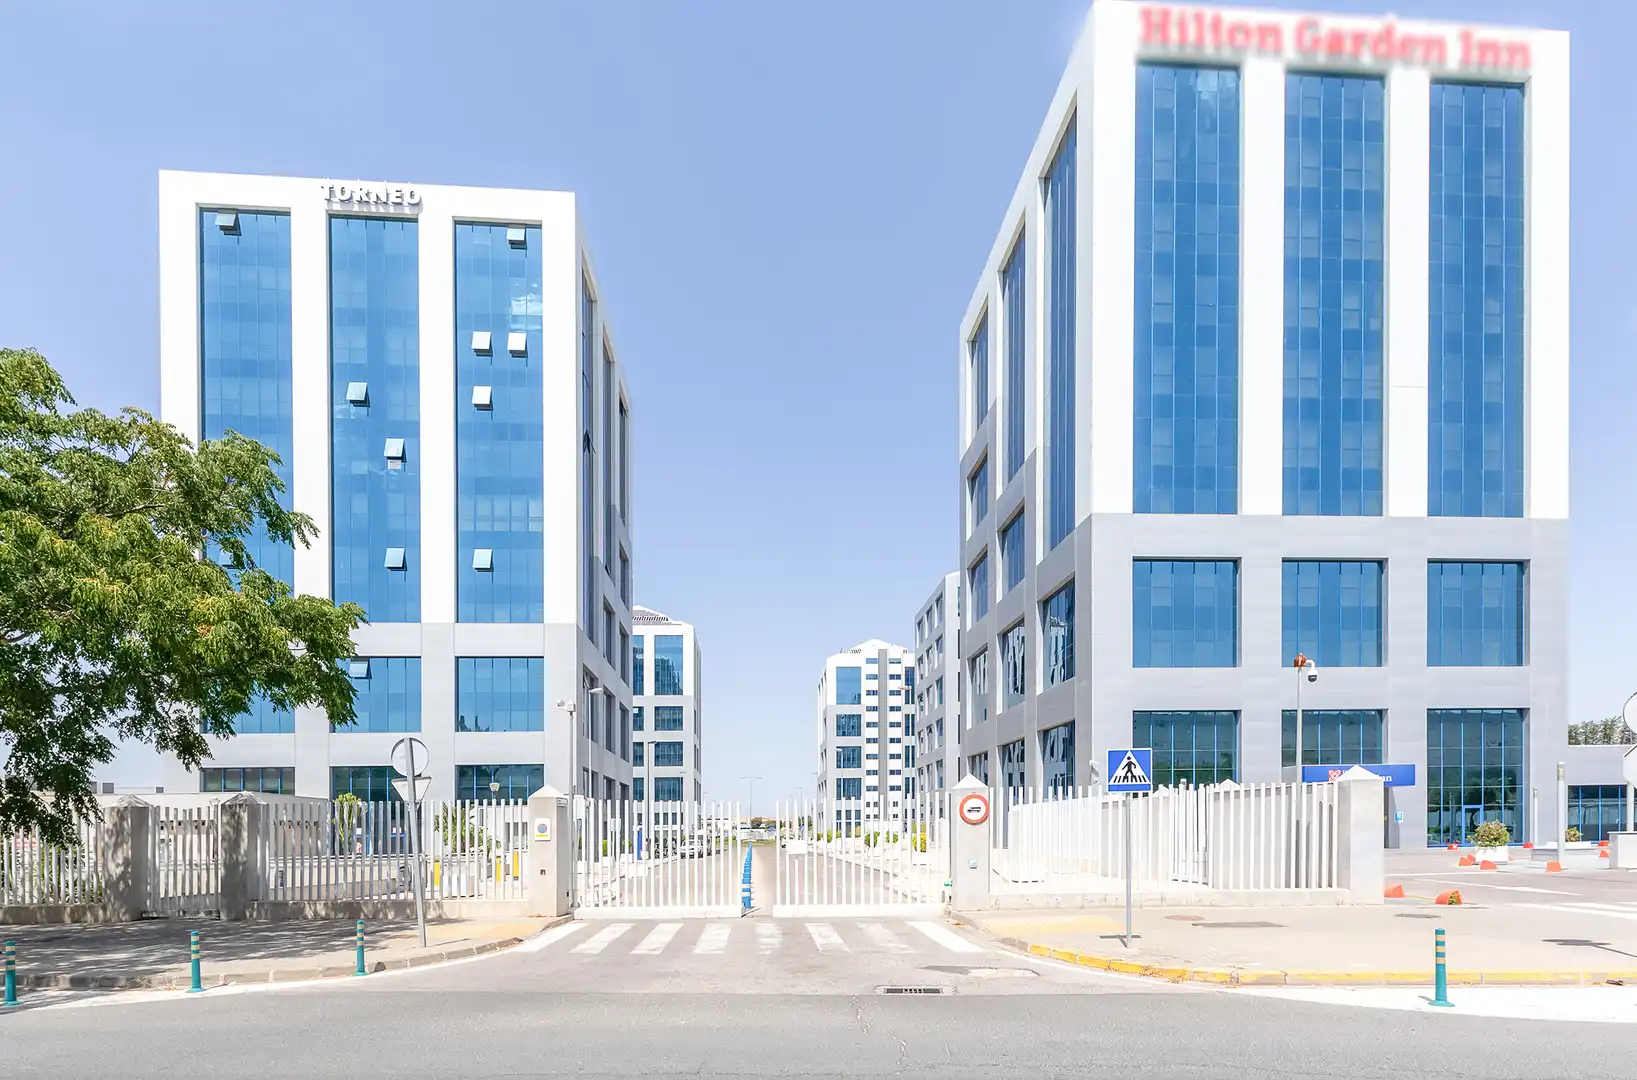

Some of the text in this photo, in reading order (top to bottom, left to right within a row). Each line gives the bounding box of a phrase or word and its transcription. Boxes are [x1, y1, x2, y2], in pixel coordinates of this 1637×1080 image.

[1140, 6, 1532, 68] Hilton Garden Inn
[320, 181, 422, 205] TORNEO
